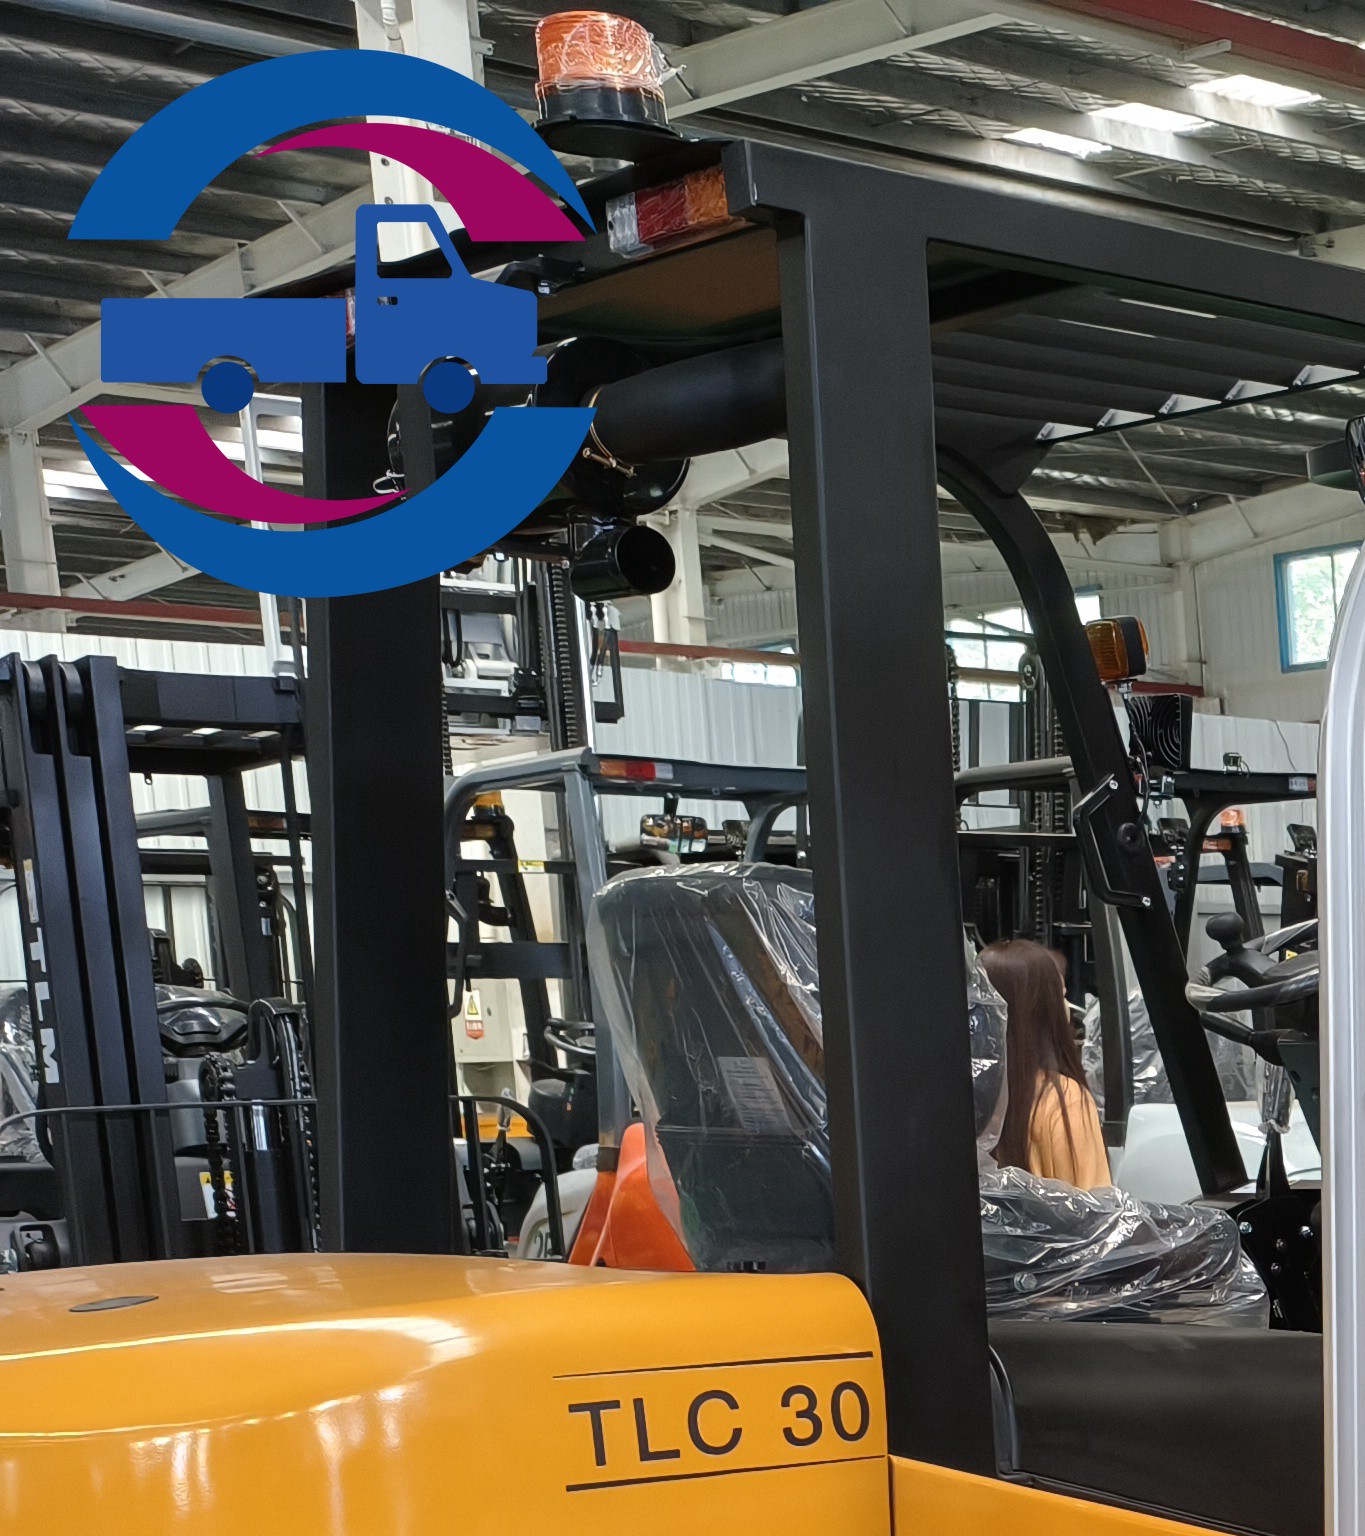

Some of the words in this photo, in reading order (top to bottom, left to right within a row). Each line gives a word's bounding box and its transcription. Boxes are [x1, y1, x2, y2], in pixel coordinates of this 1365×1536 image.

[30, 927, 60, 1084] TLM
[568, 1389, 743, 1467] TLC
[780, 1381, 870, 1447] 30
